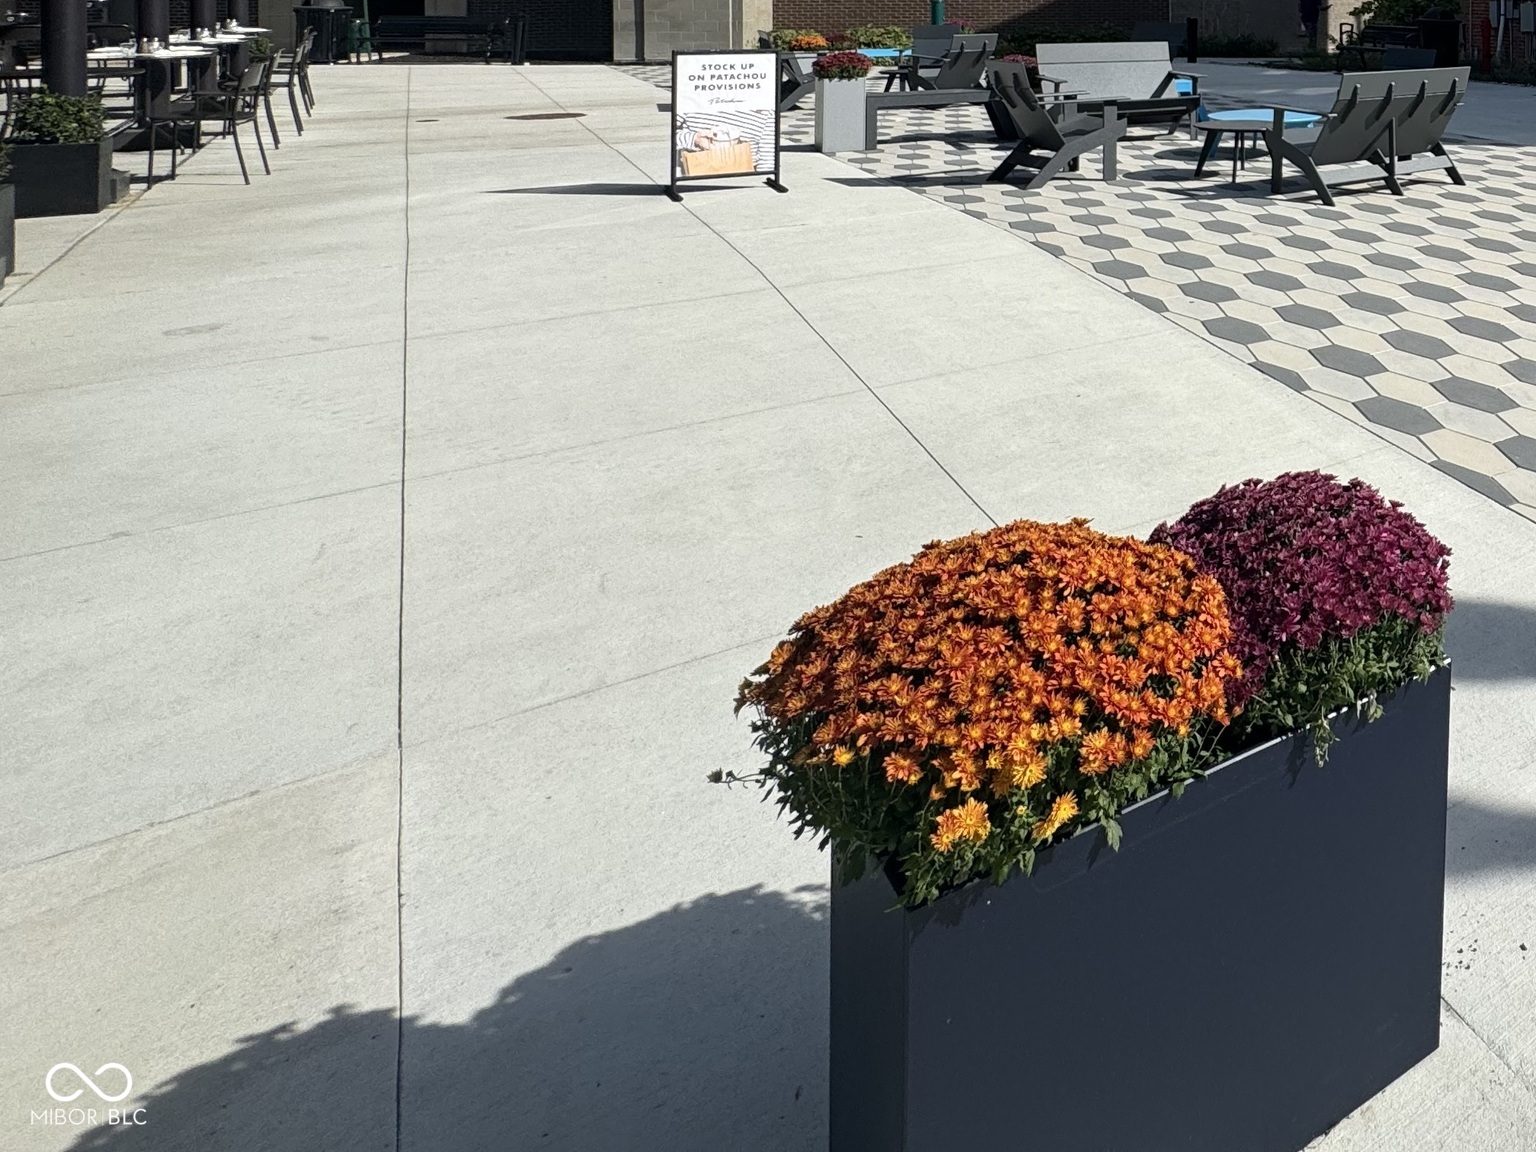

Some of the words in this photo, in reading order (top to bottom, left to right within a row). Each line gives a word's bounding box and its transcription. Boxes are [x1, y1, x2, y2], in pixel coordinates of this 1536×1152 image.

[701, 63, 736, 71] STOCK
[710, 73, 767, 81] PATACHOU
[694, 82, 761, 91] PROVISIONS
